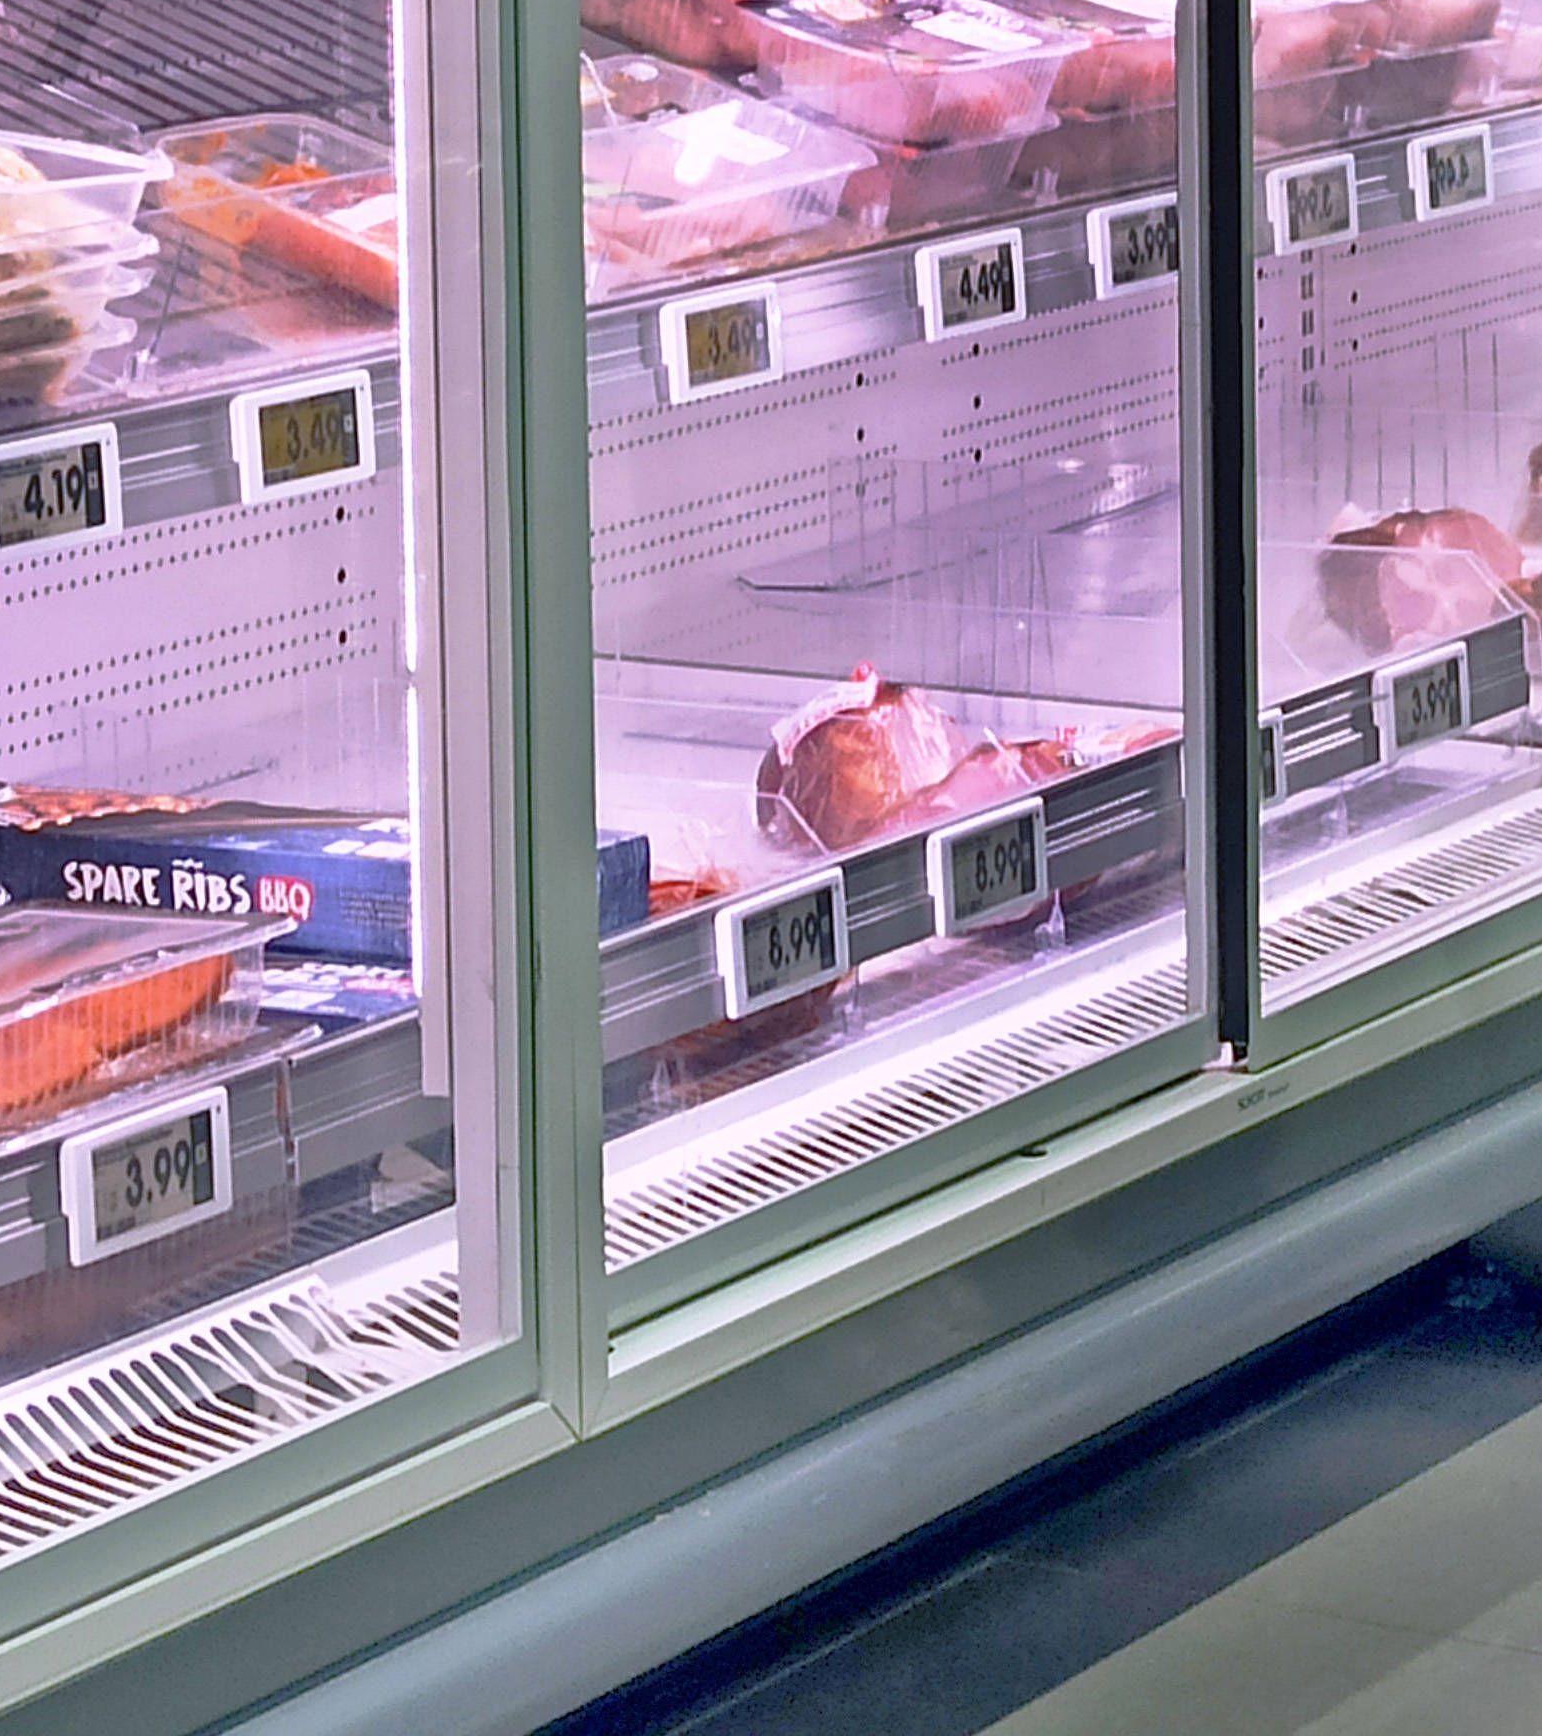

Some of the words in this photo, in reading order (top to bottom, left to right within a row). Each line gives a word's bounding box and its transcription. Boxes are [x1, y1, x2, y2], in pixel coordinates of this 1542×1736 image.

[1127, 218, 1170, 264] 3.99
[959, 263, 1003, 307] 4.49
[707, 314, 755, 365] 3.49
[286, 409, 341, 461] 3.49
[23, 465, 83, 520] 4.19
[63, 860, 161, 906] SPARE
[171, 860, 251, 914] RIBS
[259, 877, 312, 921] BBQ
[975, 841, 1021, 892] 8.99
[768, 912, 818, 970] 8.99
[125, 1140, 190, 1207] 3.99
